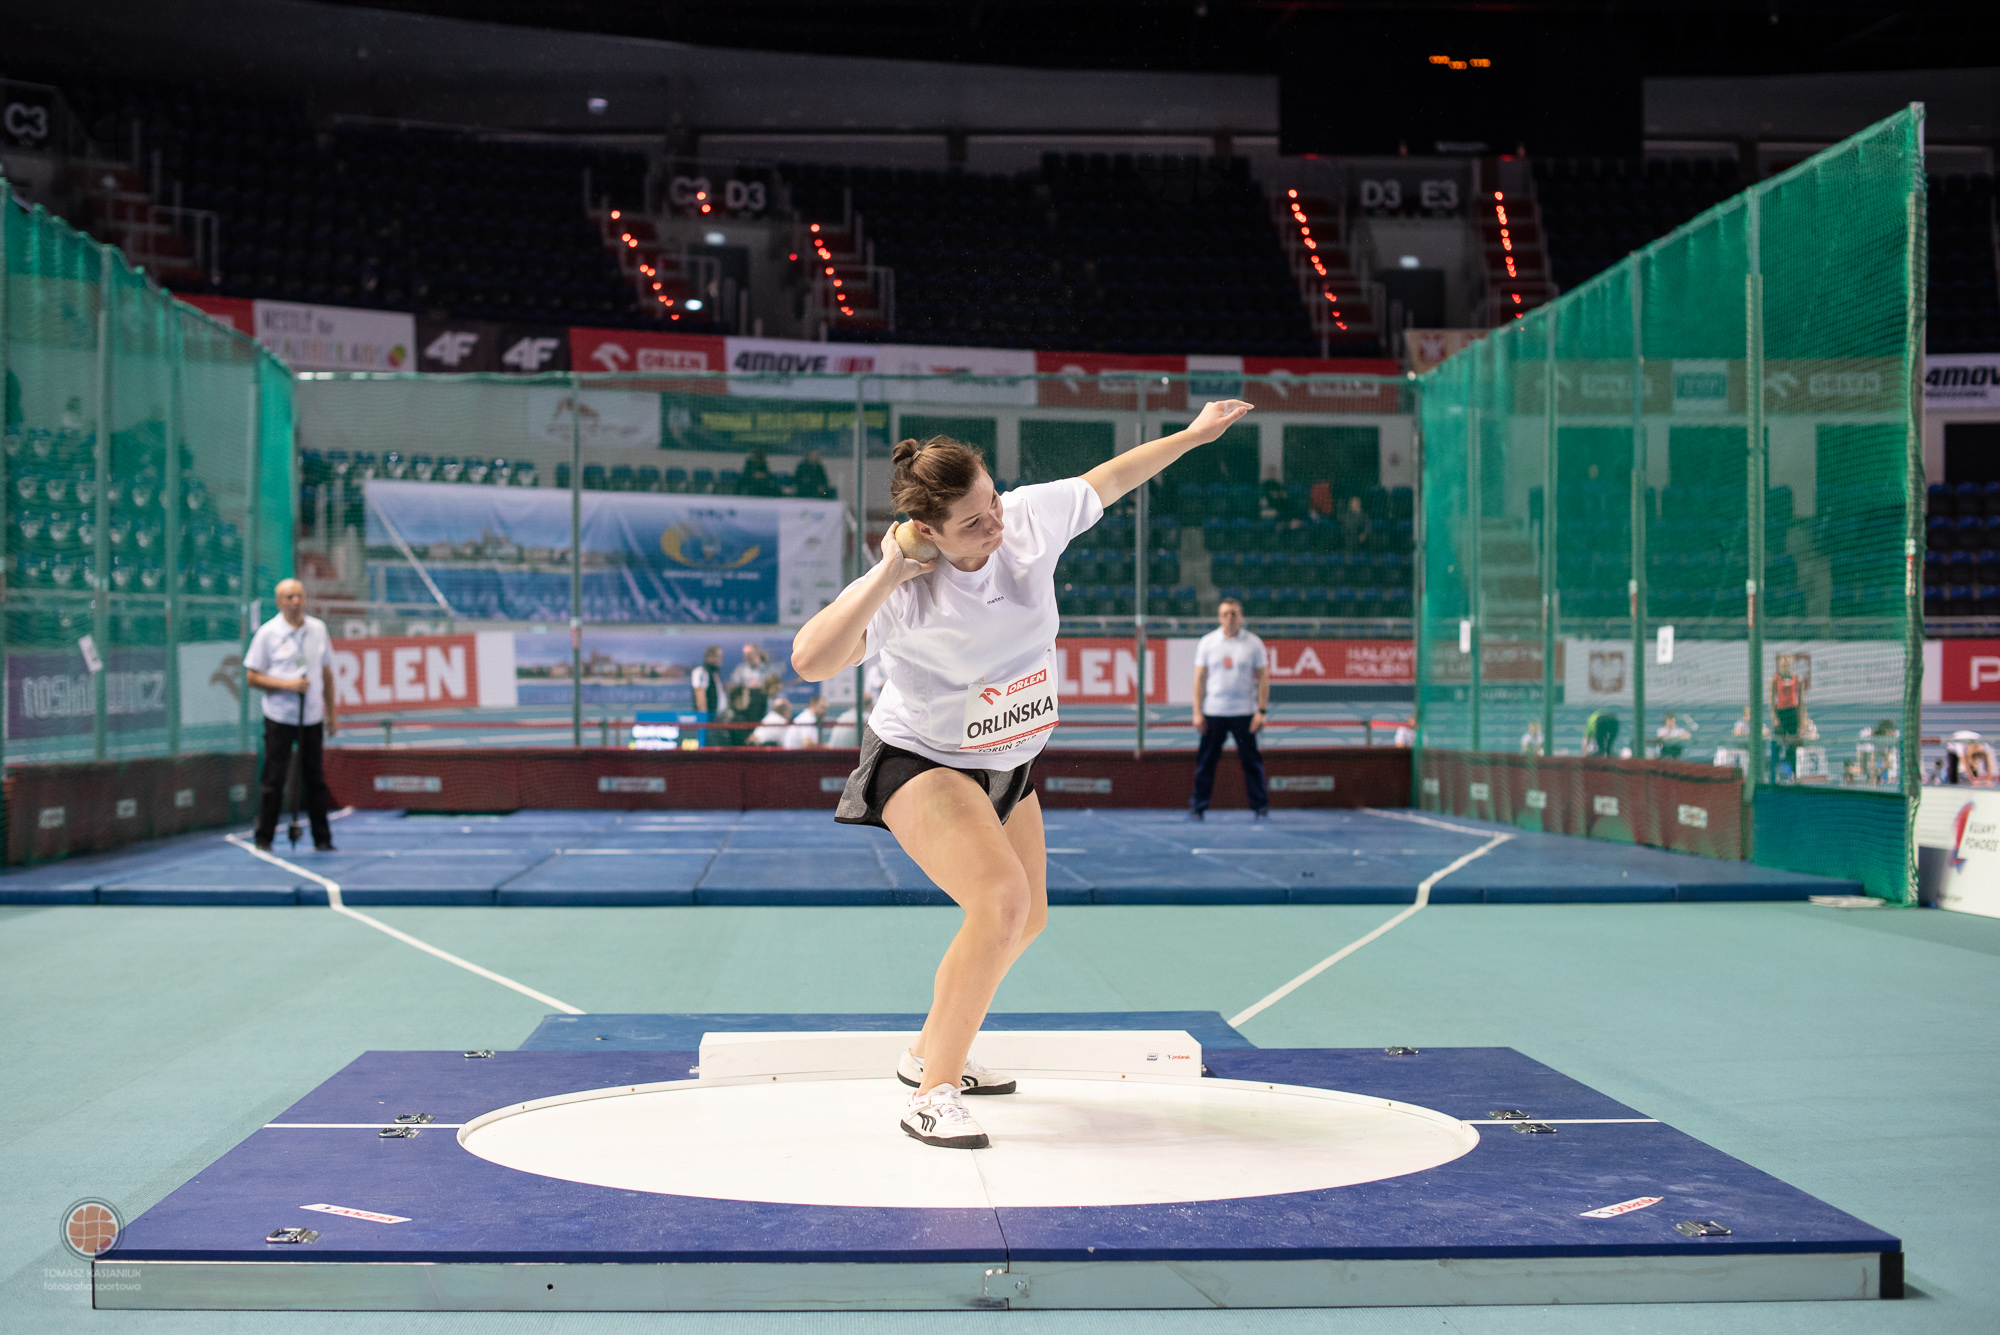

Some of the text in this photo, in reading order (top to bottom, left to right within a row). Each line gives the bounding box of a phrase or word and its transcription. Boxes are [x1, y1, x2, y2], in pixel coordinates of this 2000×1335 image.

[4, 103, 48, 137] C3
[725, 180, 766, 211] D3
[1360, 180, 1458, 208] D3 E3
[425, 330, 479, 366] 4F
[503, 336, 560, 371] 4F
[333, 645, 468, 706] RLEN
[1056, 648, 1155, 697] LEN
[1268, 646, 1326, 676] LA
[1008, 671, 1046, 694] ORLEN
[967, 695, 1054, 739] ORLIŃSKA
